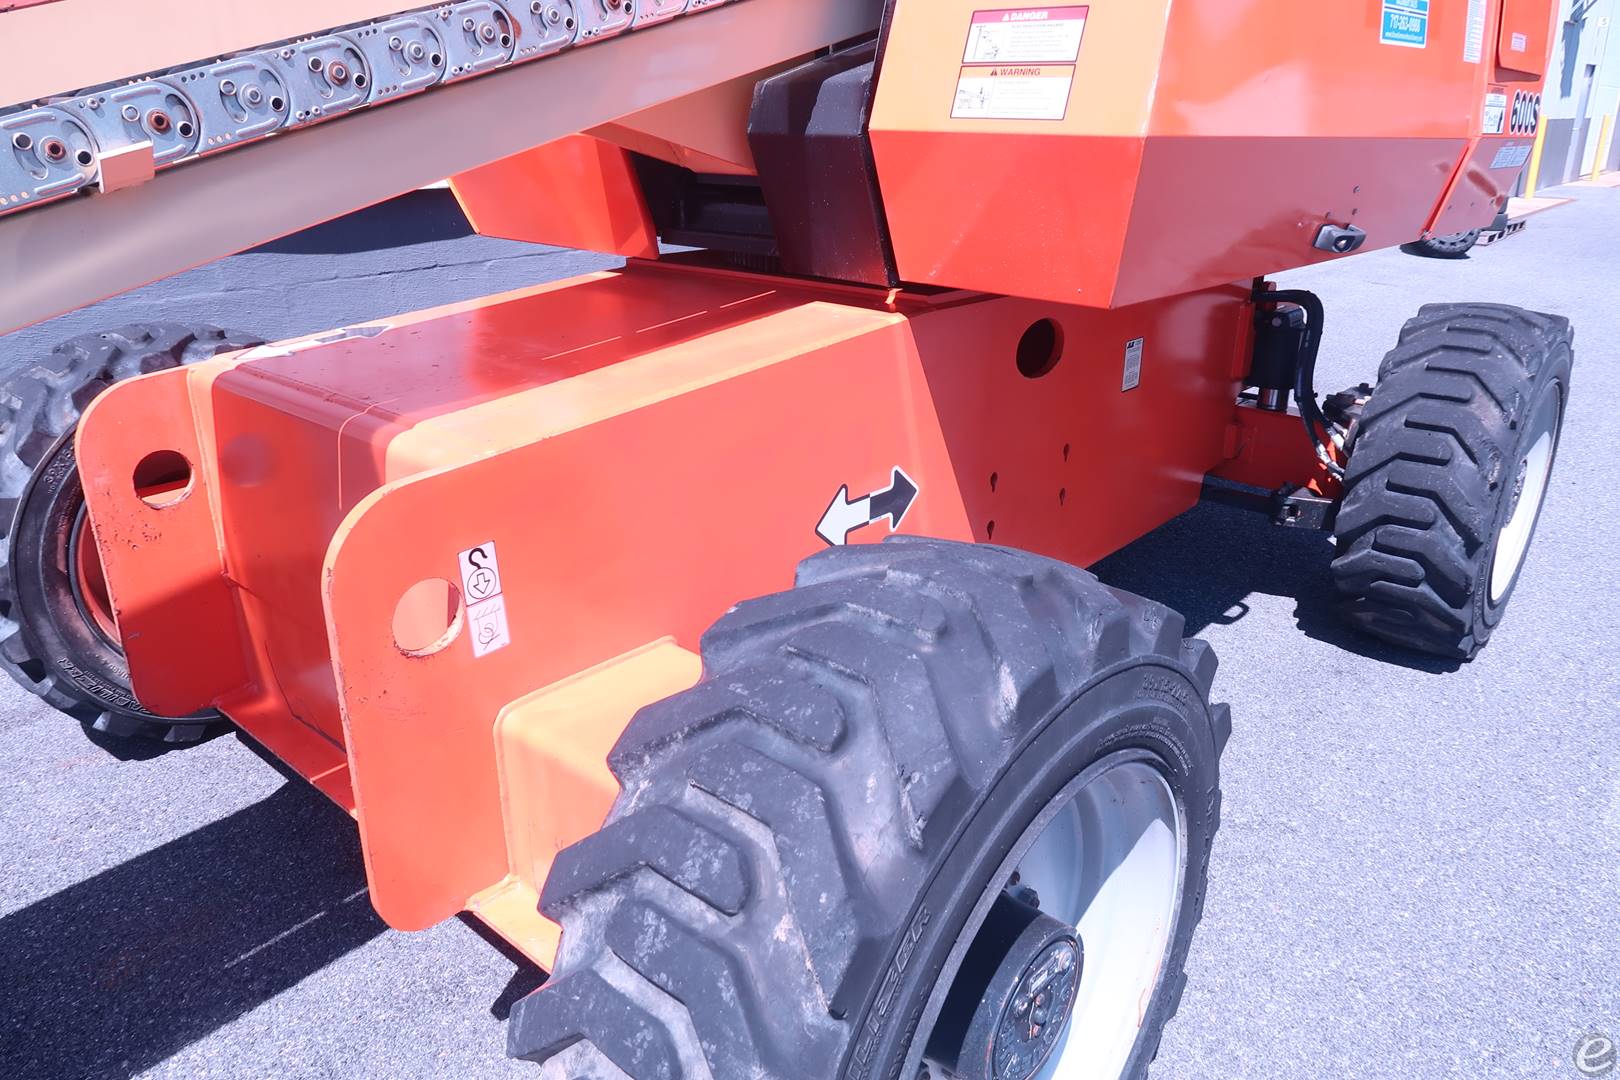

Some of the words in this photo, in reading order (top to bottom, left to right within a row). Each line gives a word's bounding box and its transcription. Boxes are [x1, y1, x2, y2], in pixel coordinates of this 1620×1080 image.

[1010, 10, 1049, 21] DANGER
[1000, 67, 1041, 77] WARNING
[1509, 89, 1541, 136] 600S
